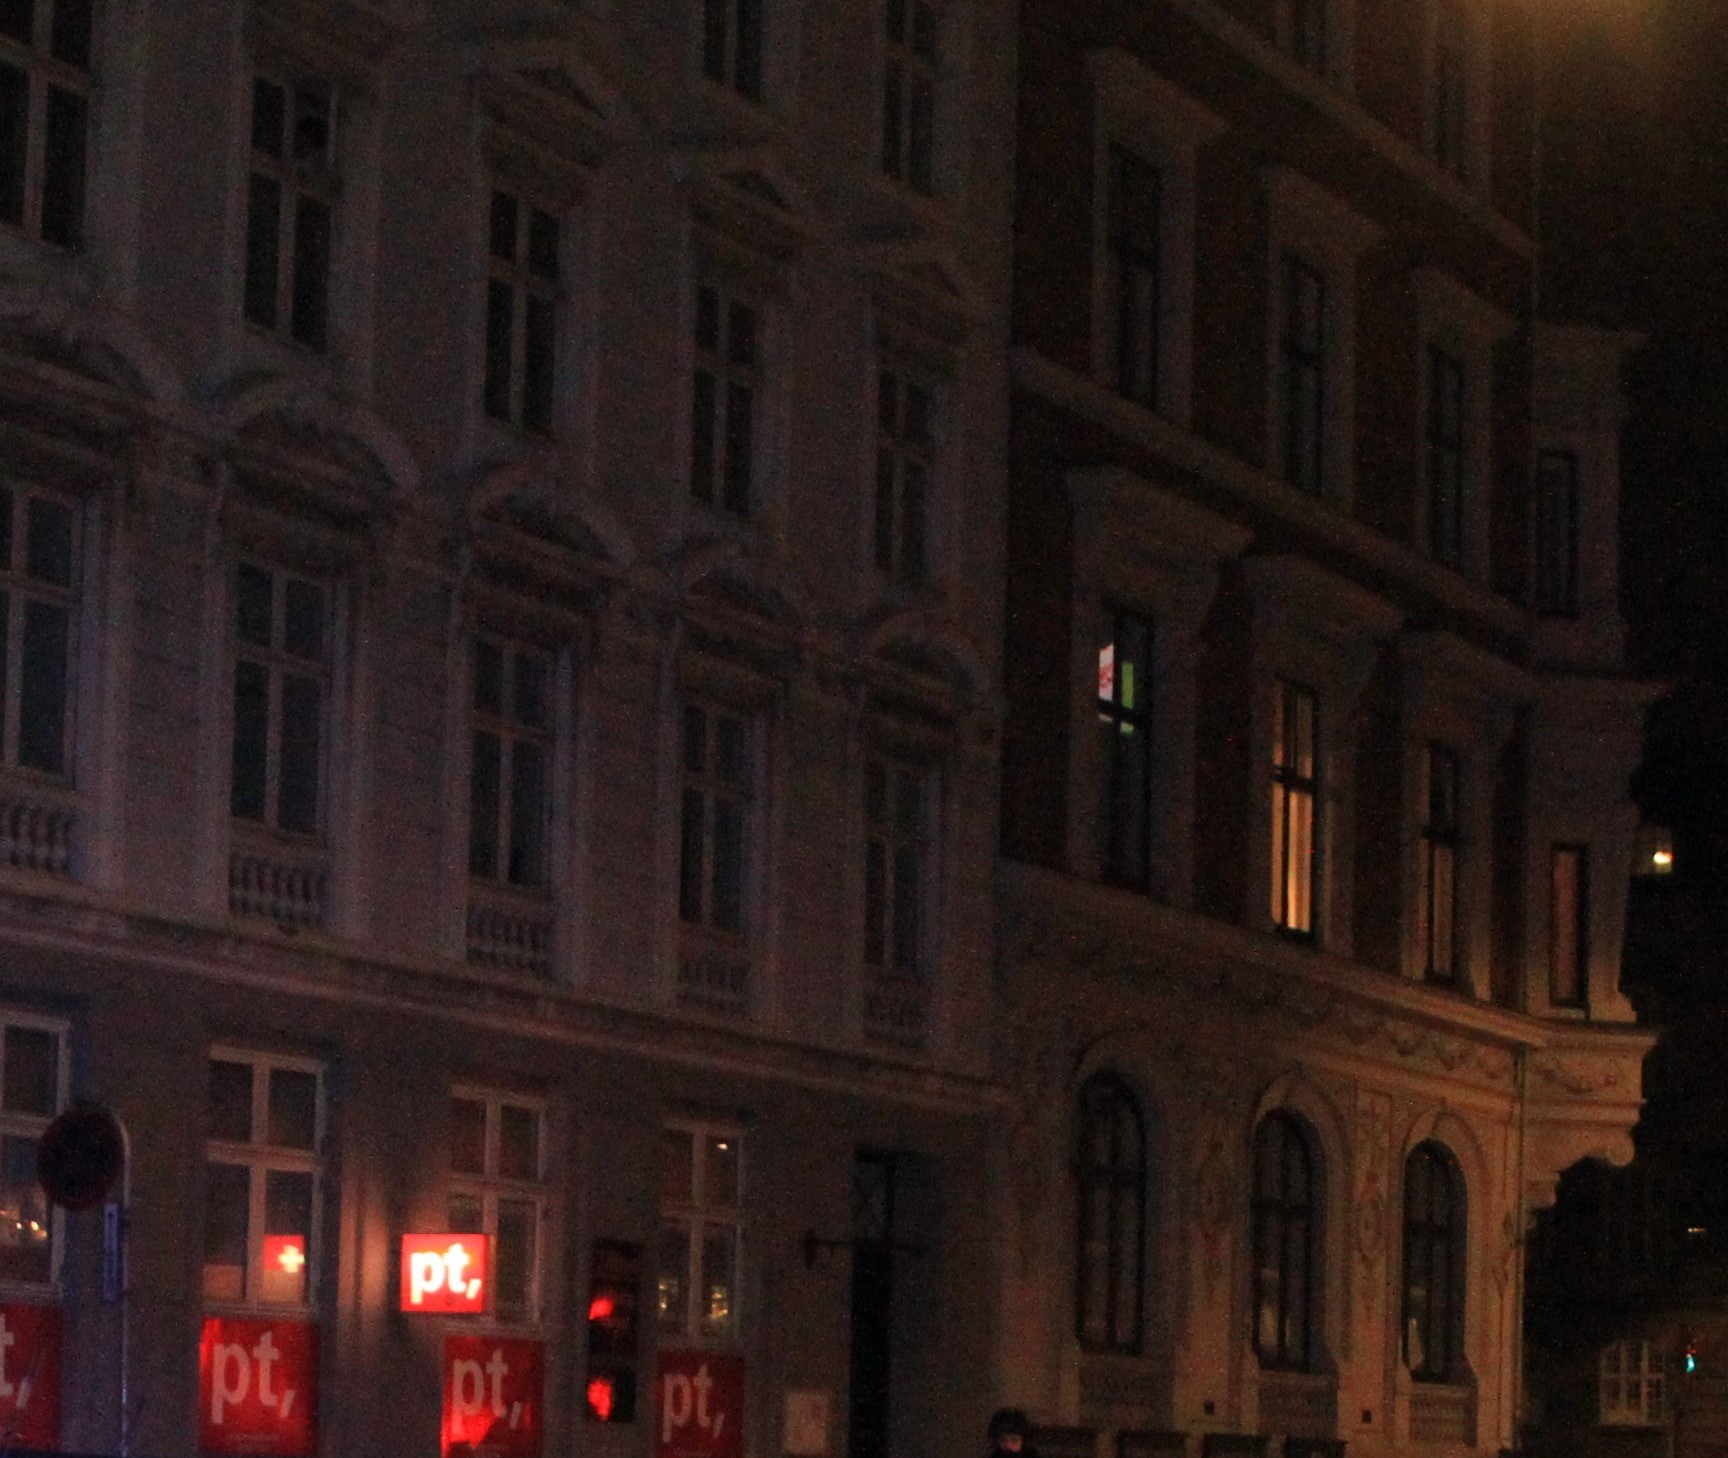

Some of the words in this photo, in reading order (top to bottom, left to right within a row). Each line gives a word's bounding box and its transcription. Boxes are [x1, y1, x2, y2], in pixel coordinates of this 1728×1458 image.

[409, 1242, 482, 1304] pt,
[211, 1330, 297, 1425] pt,
[451, 1348, 522, 1436] pt,
[662, 1363, 726, 1444] pt,
